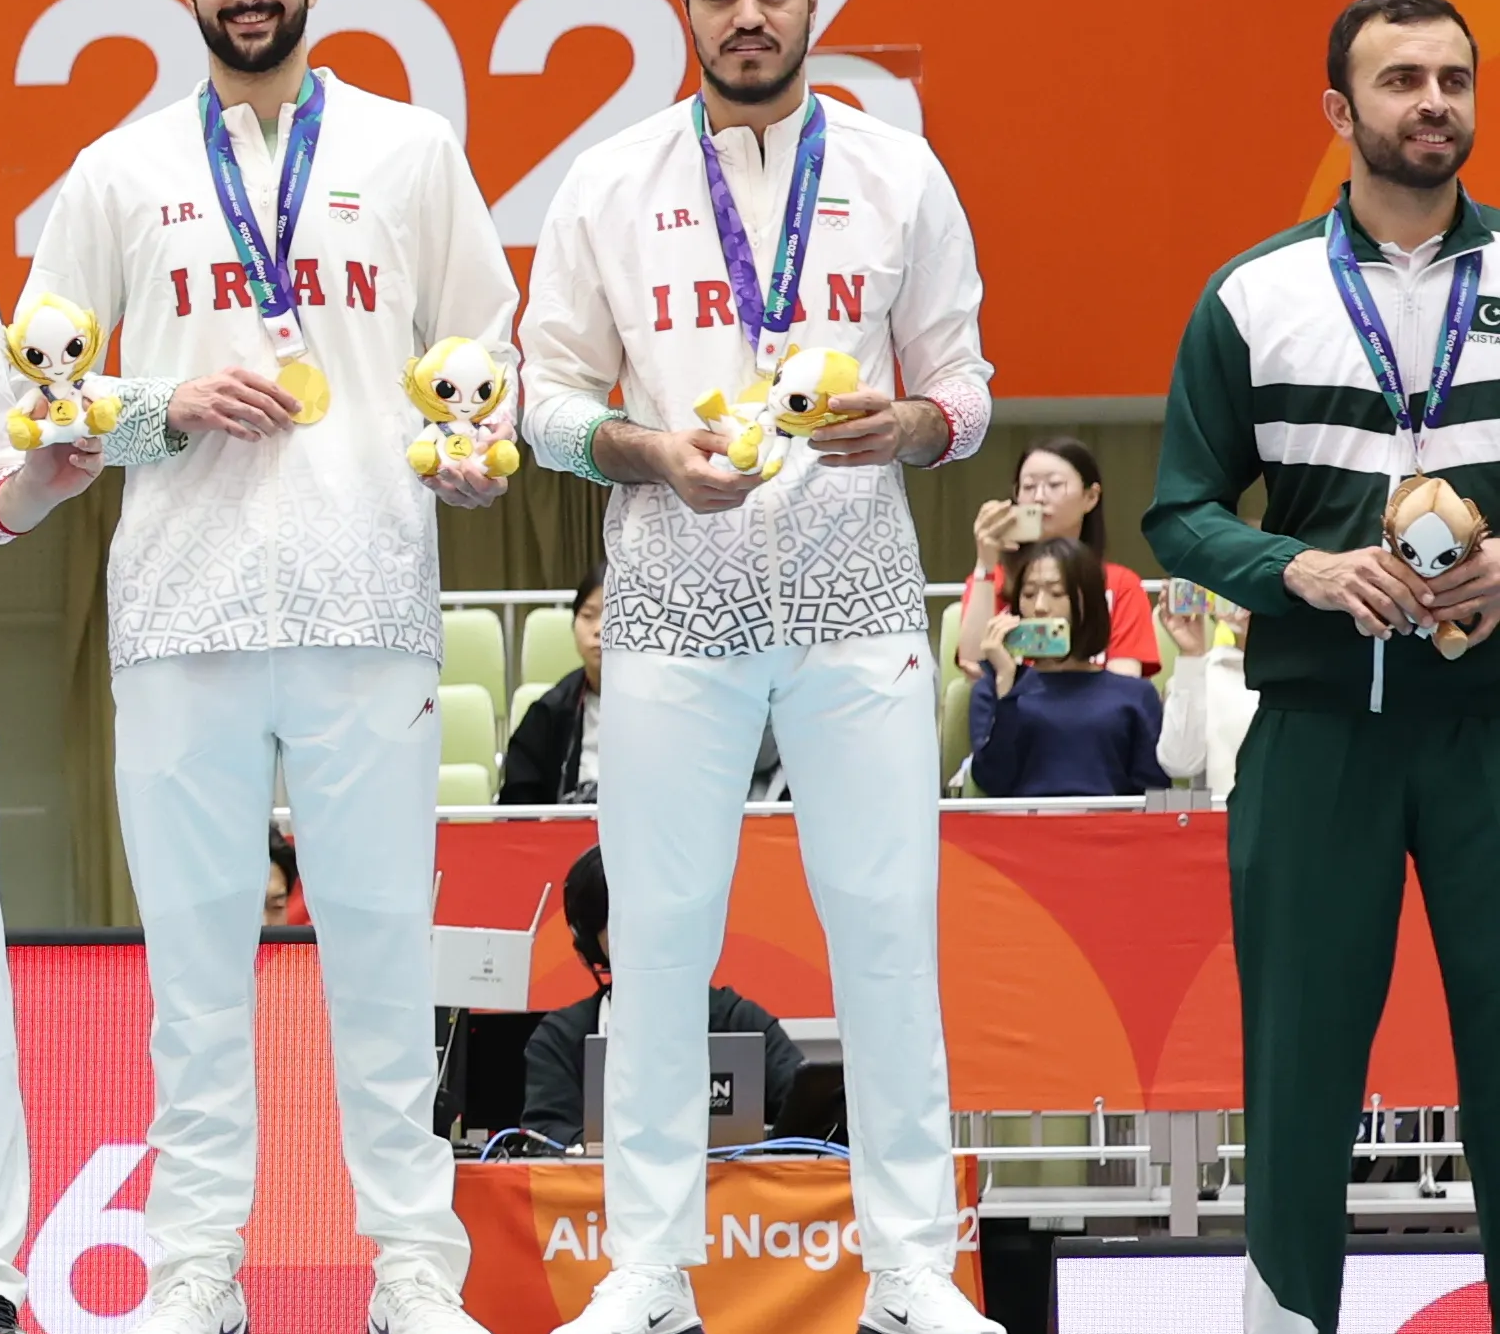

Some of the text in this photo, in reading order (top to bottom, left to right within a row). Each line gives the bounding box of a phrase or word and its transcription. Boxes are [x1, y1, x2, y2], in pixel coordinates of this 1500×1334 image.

[160, 202, 203, 226] I.R.
[655, 208, 699, 231] I.R.
[238, 221, 277, 305] Aichi-Nagoya 2026
[170, 259, 378, 317] IRAN
[773, 234, 799, 320] Aichi-Nagoya 2026
[652, 273, 865, 332] IRN
[1368, 331, 1385, 355] 2026
[1445, 329, 1458, 352] 2026
[1467, 332, 1500, 345] KISTA
